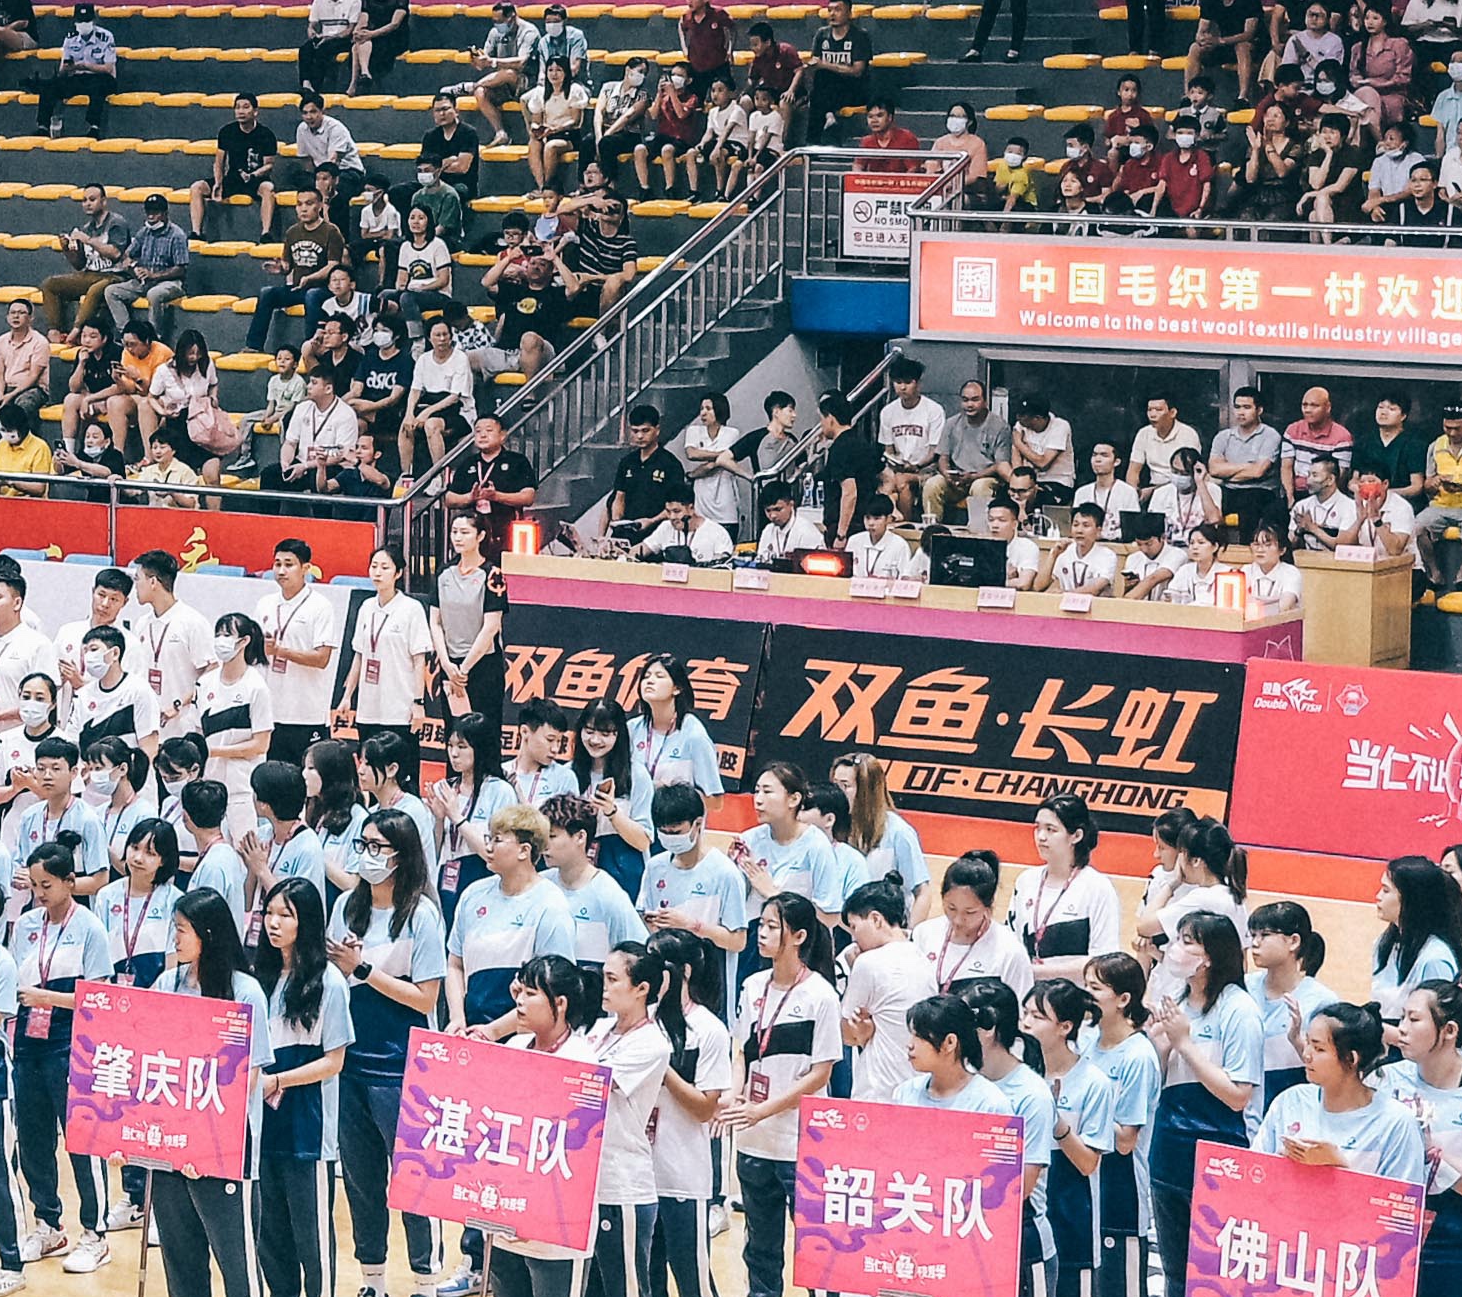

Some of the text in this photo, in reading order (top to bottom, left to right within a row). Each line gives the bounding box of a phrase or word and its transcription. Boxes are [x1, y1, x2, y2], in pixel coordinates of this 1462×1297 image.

[874, 217, 887, 226] NO
[1018, 309, 1101, 330] Welcome
[1104, 313, 1121, 331] to
[1124, 313, 1155, 333] the
[1158, 314, 1199, 335] best
[1202, 317, 1244, 338] wool
[1248, 320, 1309, 341] textile
[1312, 322, 1392, 346] industry
[781, 656, 1223, 774] 双鱼·长虹
[1253, 695, 1288, 712] Double
[1342, 738, 1447, 795] 当仁不让
[91, 1040, 227, 1116] 肇庆队
[420, 1095, 576, 1181] 湛江队
[821, 1163, 994, 1244] 韶关队
